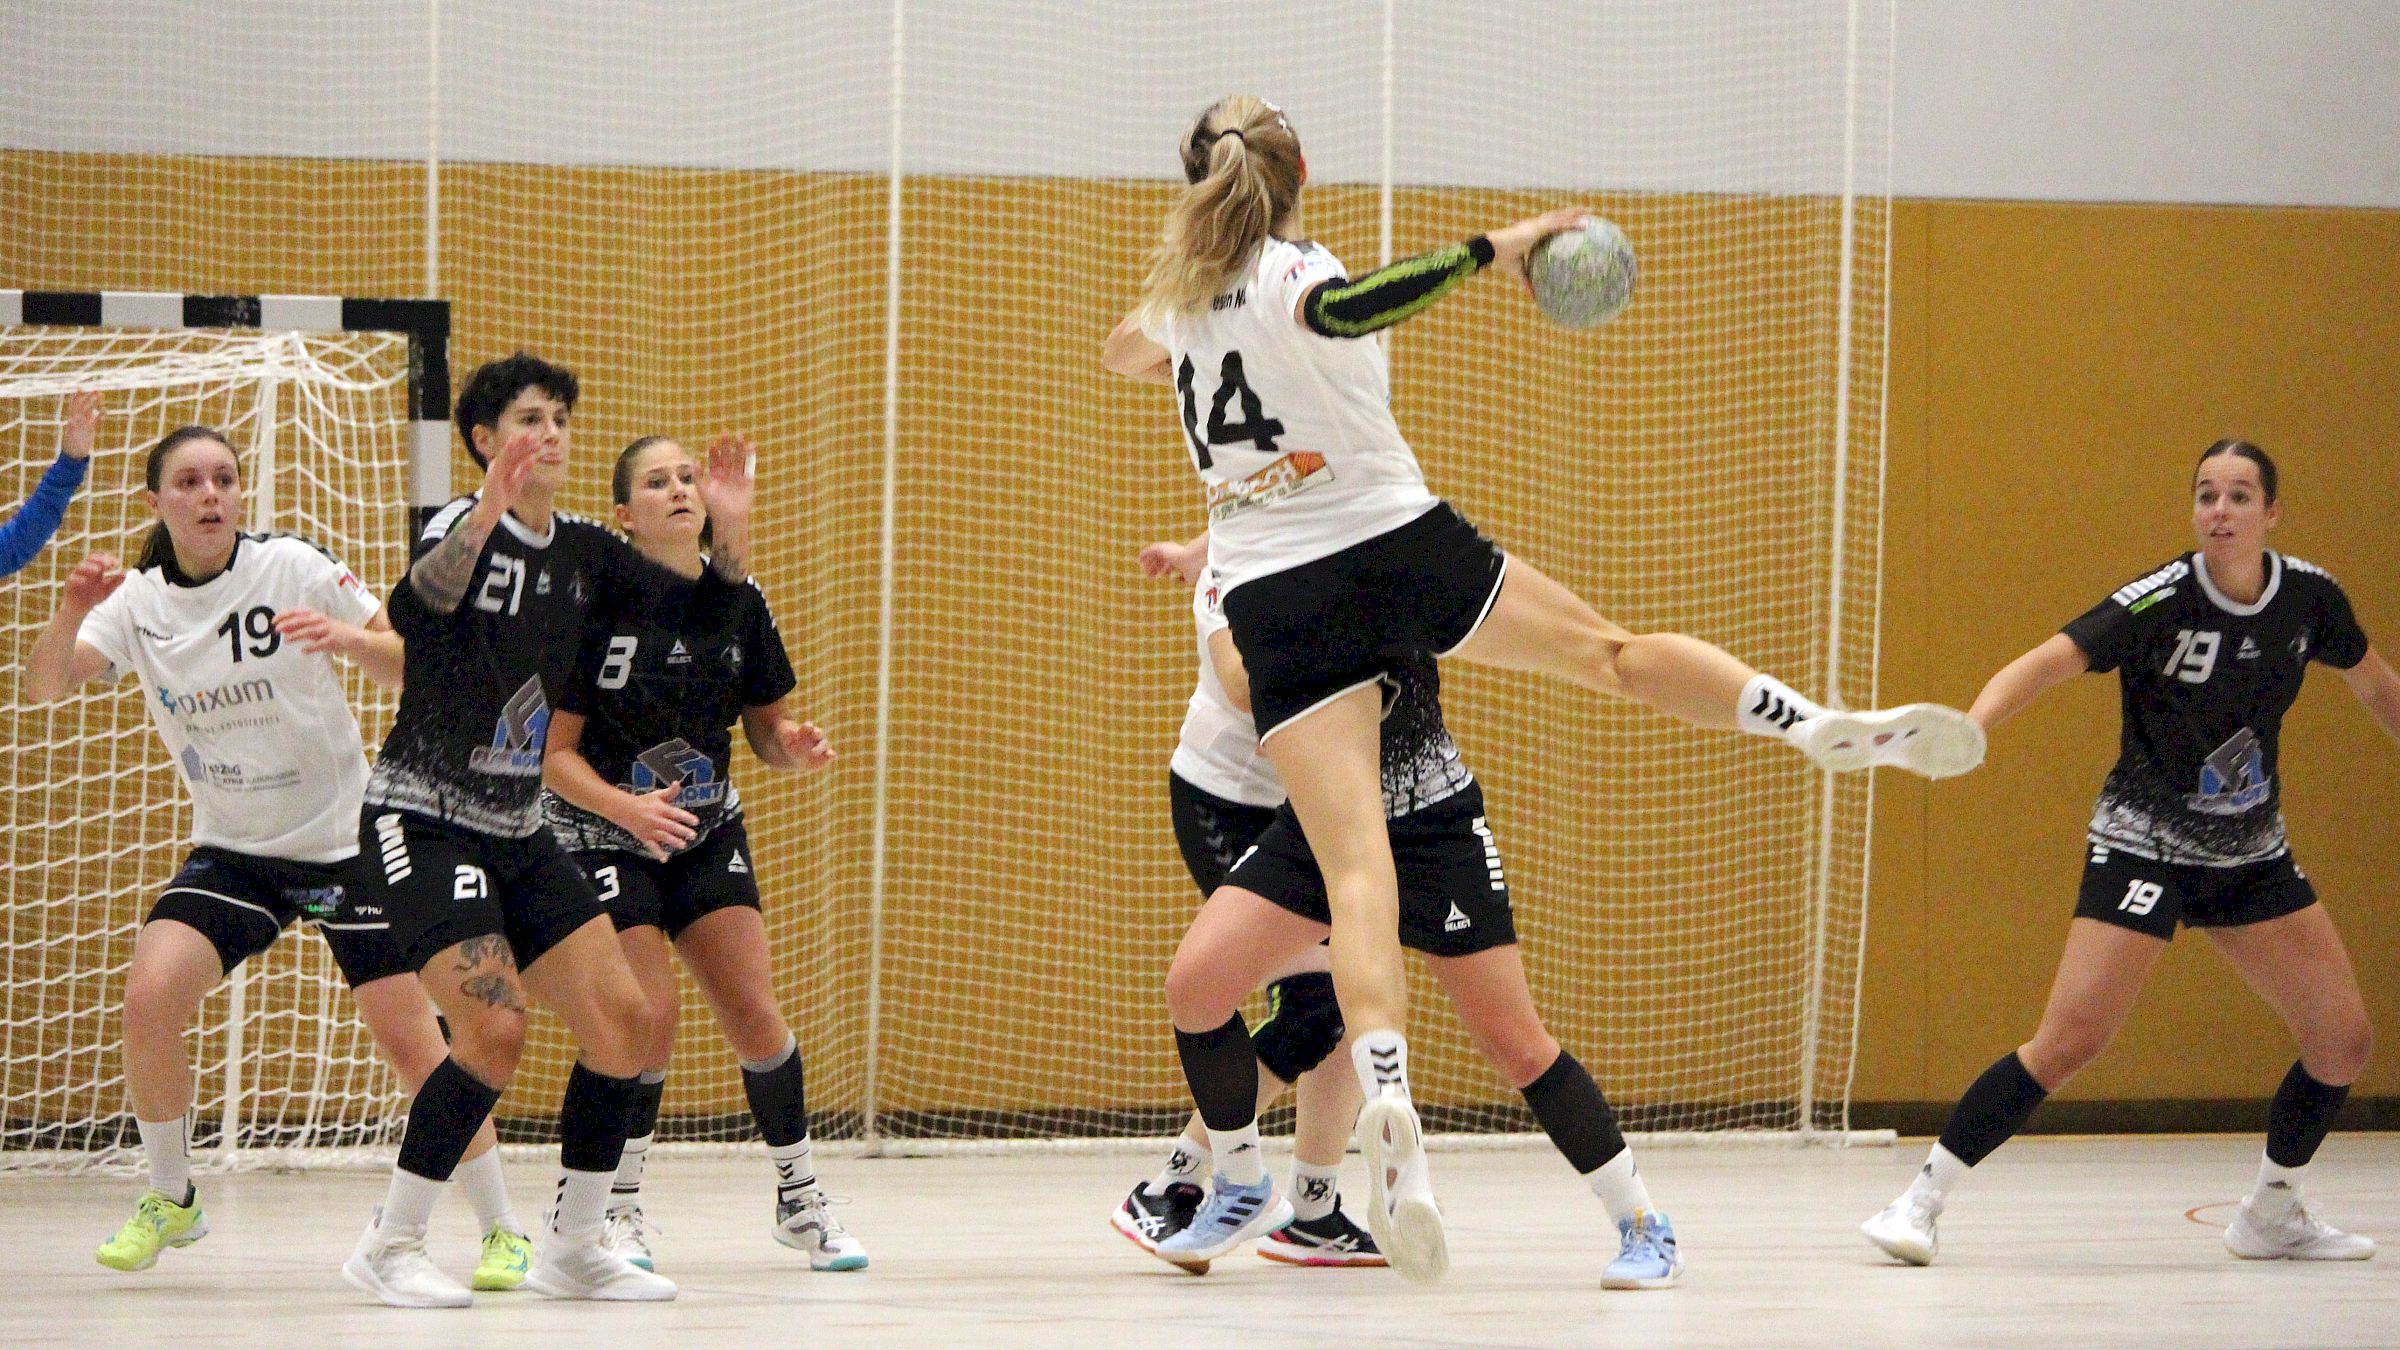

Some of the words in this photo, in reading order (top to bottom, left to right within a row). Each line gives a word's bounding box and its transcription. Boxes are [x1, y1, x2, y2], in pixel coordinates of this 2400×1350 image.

[1177, 350, 1285, 470] 14
[474, 553, 526, 617] 21
[218, 605, 282, 663] 19
[2162, 630, 2222, 684] 19
[453, 864, 488, 900] 21
[595, 865, 620, 902] 3
[2117, 879, 2164, 916] 19
